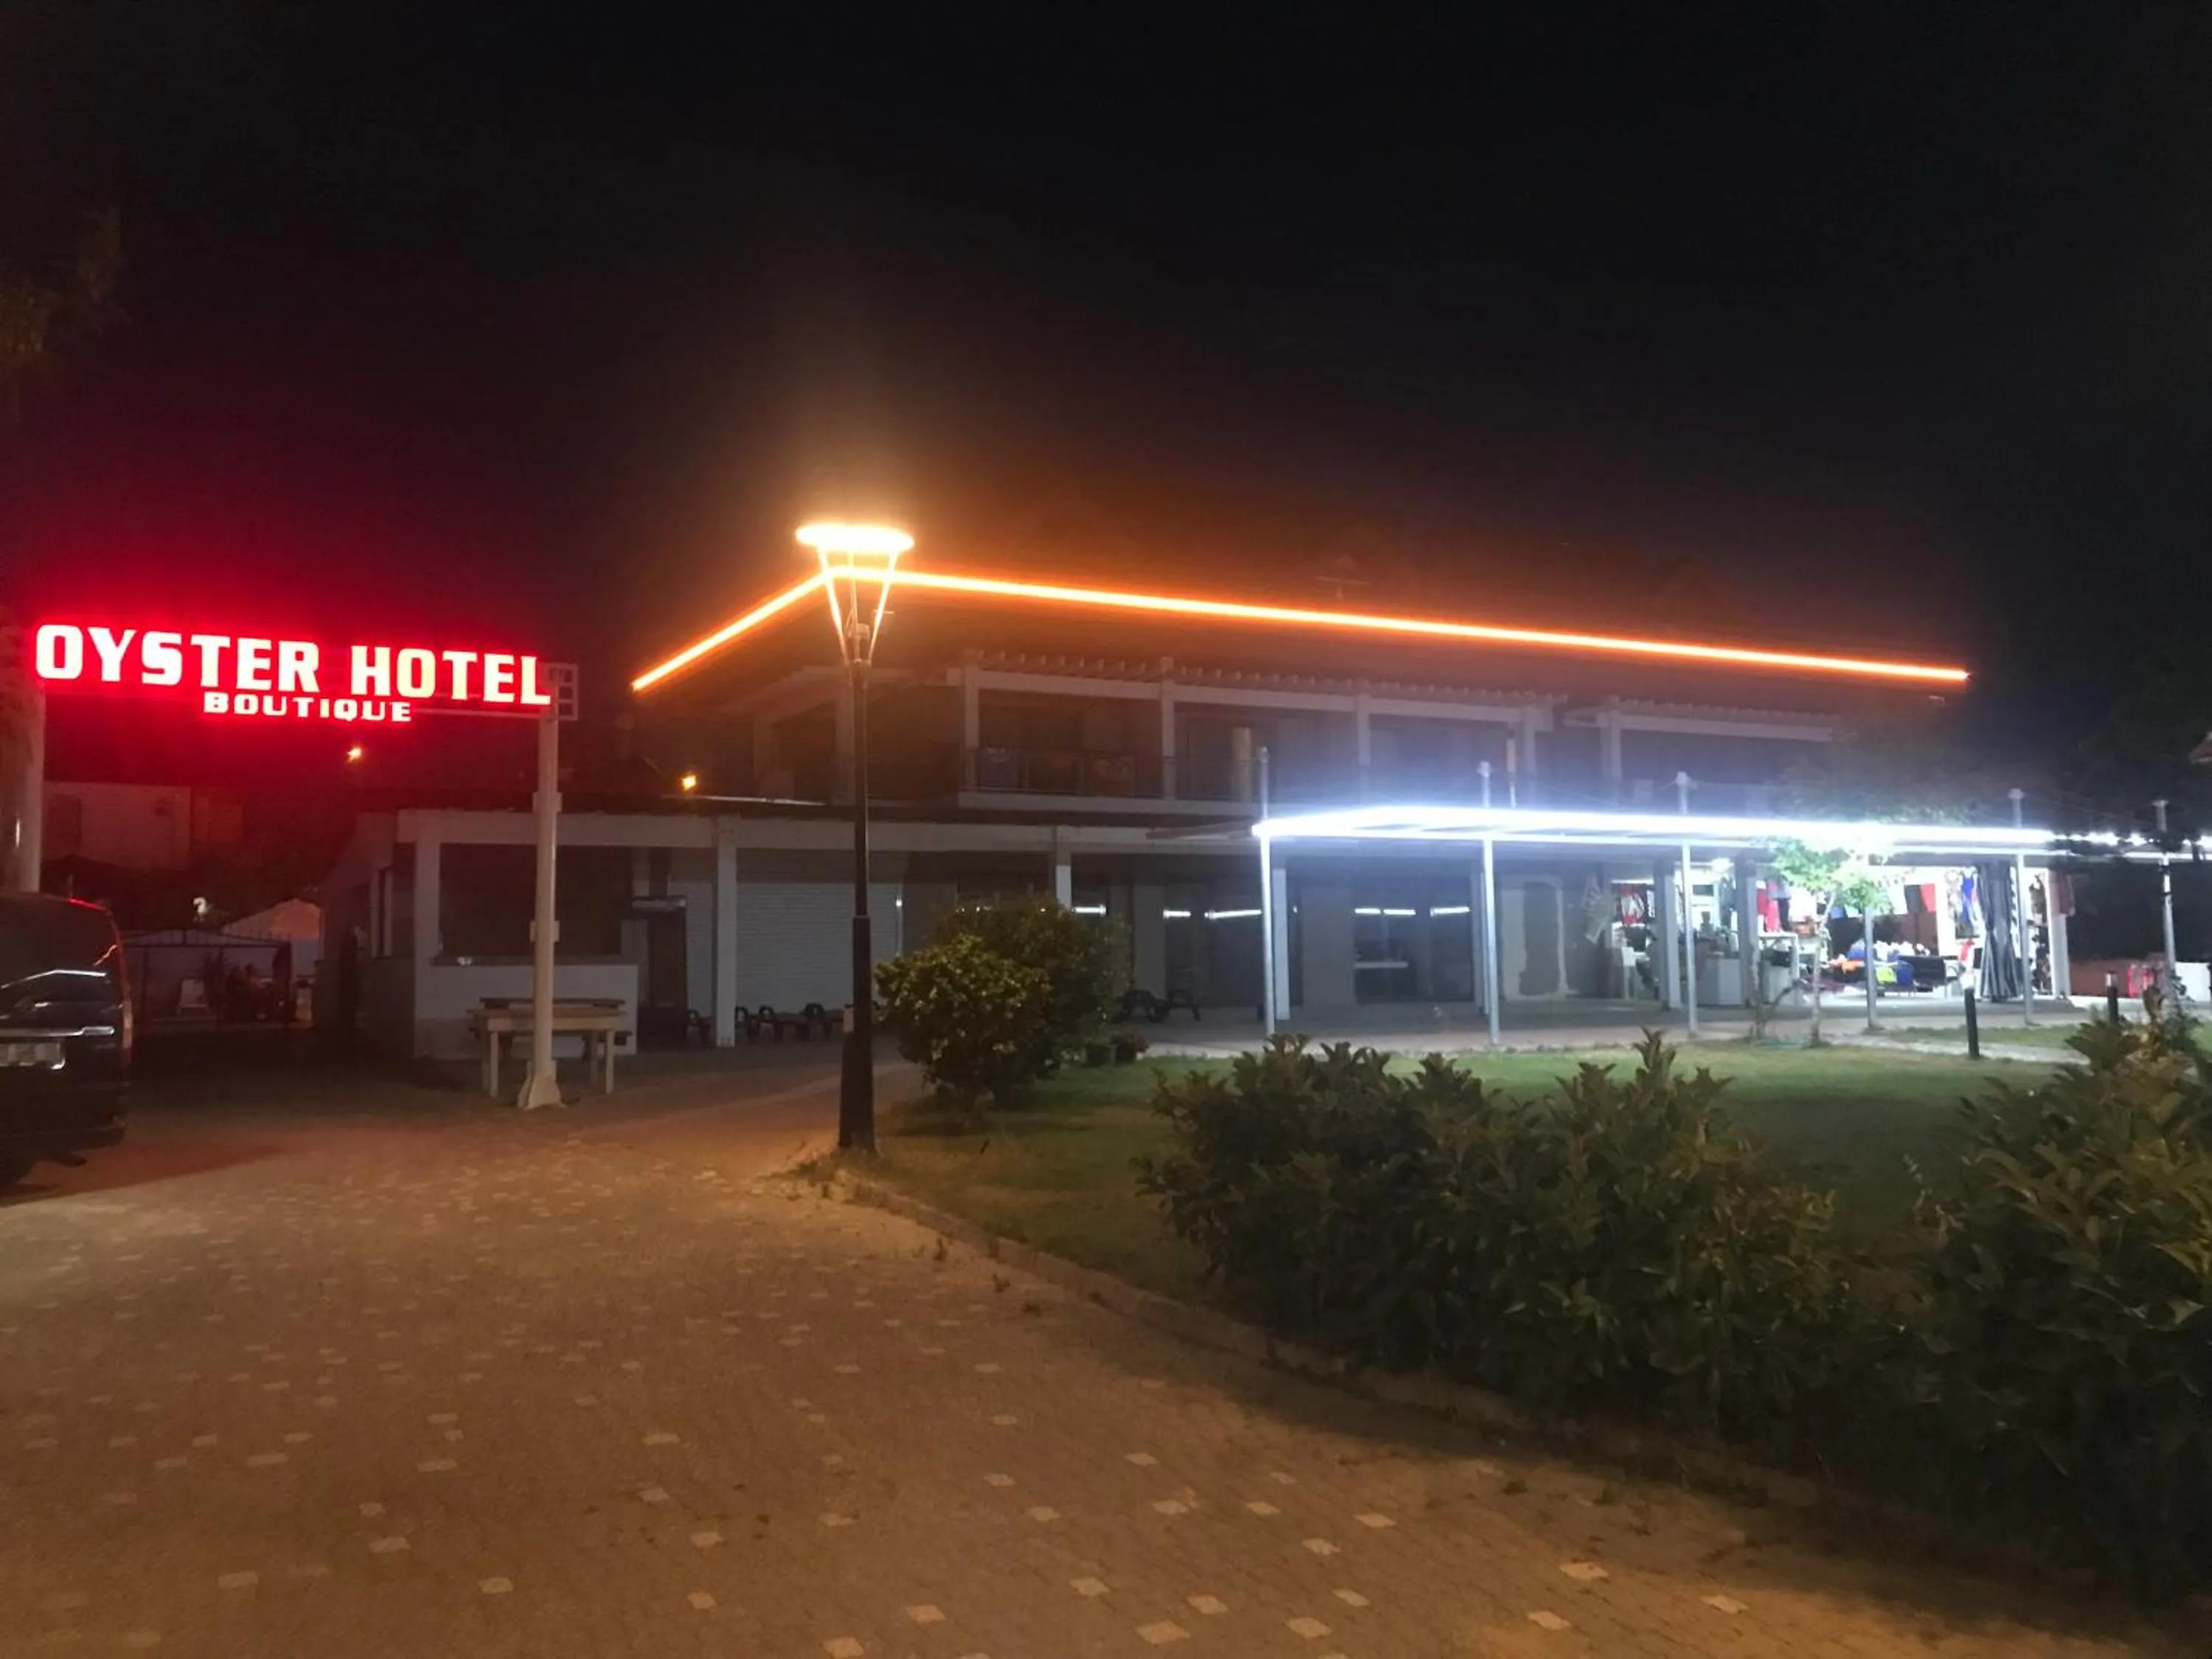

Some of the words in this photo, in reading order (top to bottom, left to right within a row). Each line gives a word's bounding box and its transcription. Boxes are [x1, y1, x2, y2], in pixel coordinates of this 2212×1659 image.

[35, 624, 320, 693] OYSTER
[350, 644, 552, 706] HOTEL
[204, 692, 411, 723] BOUTIQUE
